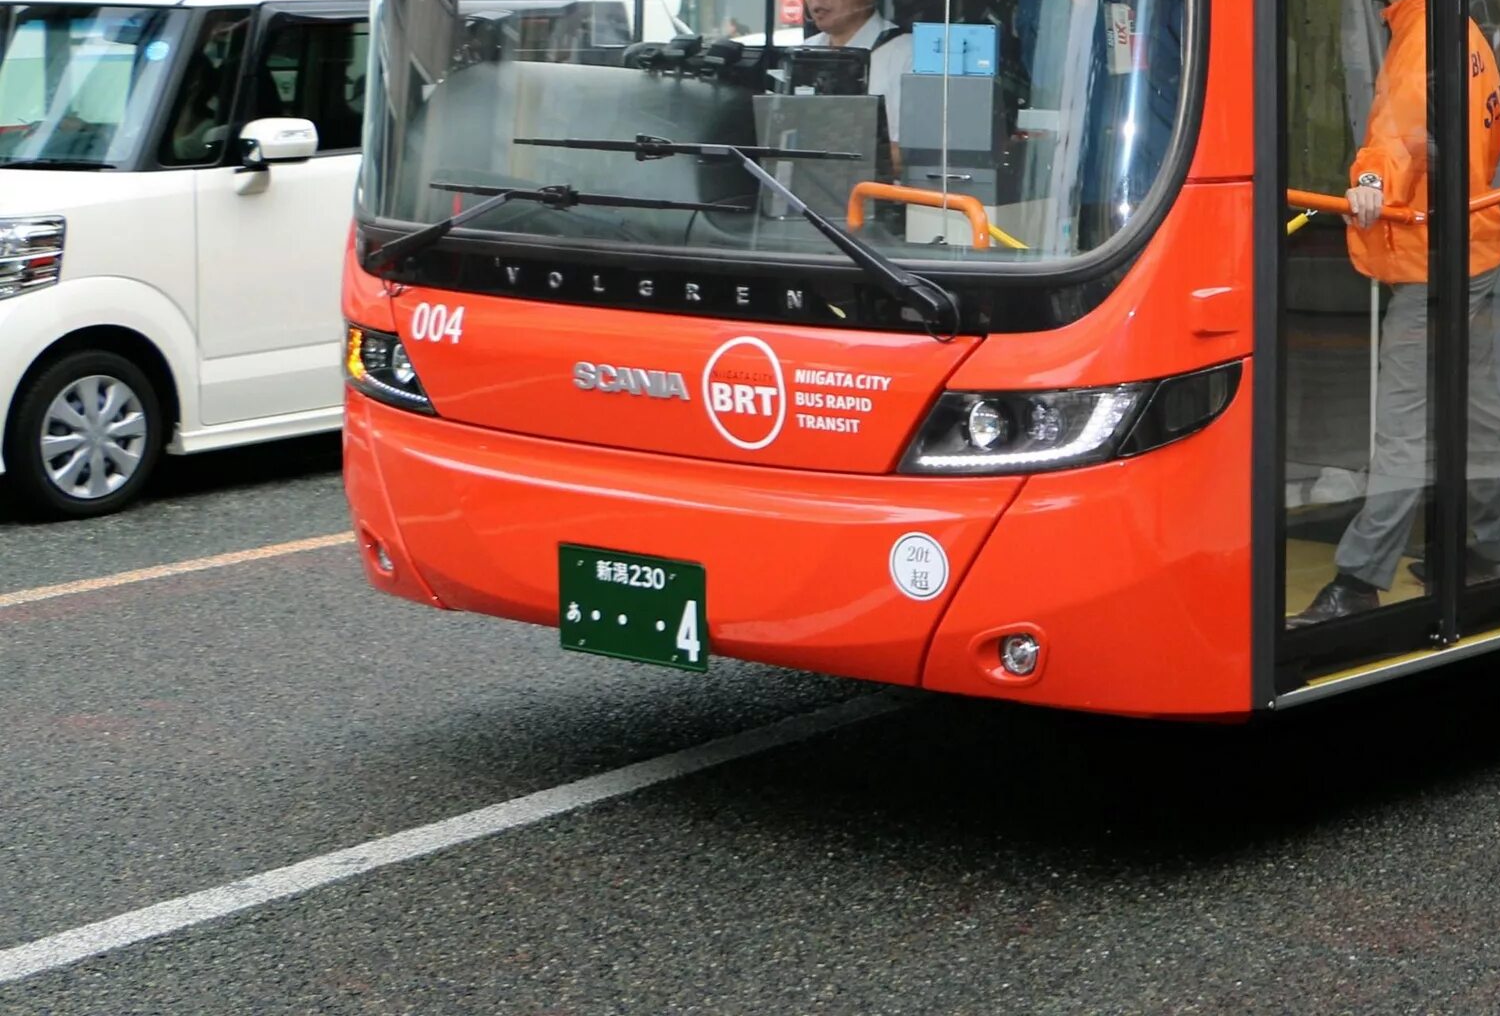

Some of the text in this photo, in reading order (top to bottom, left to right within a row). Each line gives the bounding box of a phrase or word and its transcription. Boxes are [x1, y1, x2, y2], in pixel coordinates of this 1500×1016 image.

[506, 266, 803, 310] VOLGREN
[411, 303, 464, 344] 004
[572, 361, 691, 401] SCANIA
[795, 368, 892, 391] NIIGATA CITY
[711, 381, 778, 416] BRT
[795, 392, 873, 412] BUS RAPID
[796, 413, 861, 434] TRANSIT
[906, 544, 931, 563] 20t
[910, 568, 930, 591] 超
[675, 600, 700, 663] 4
